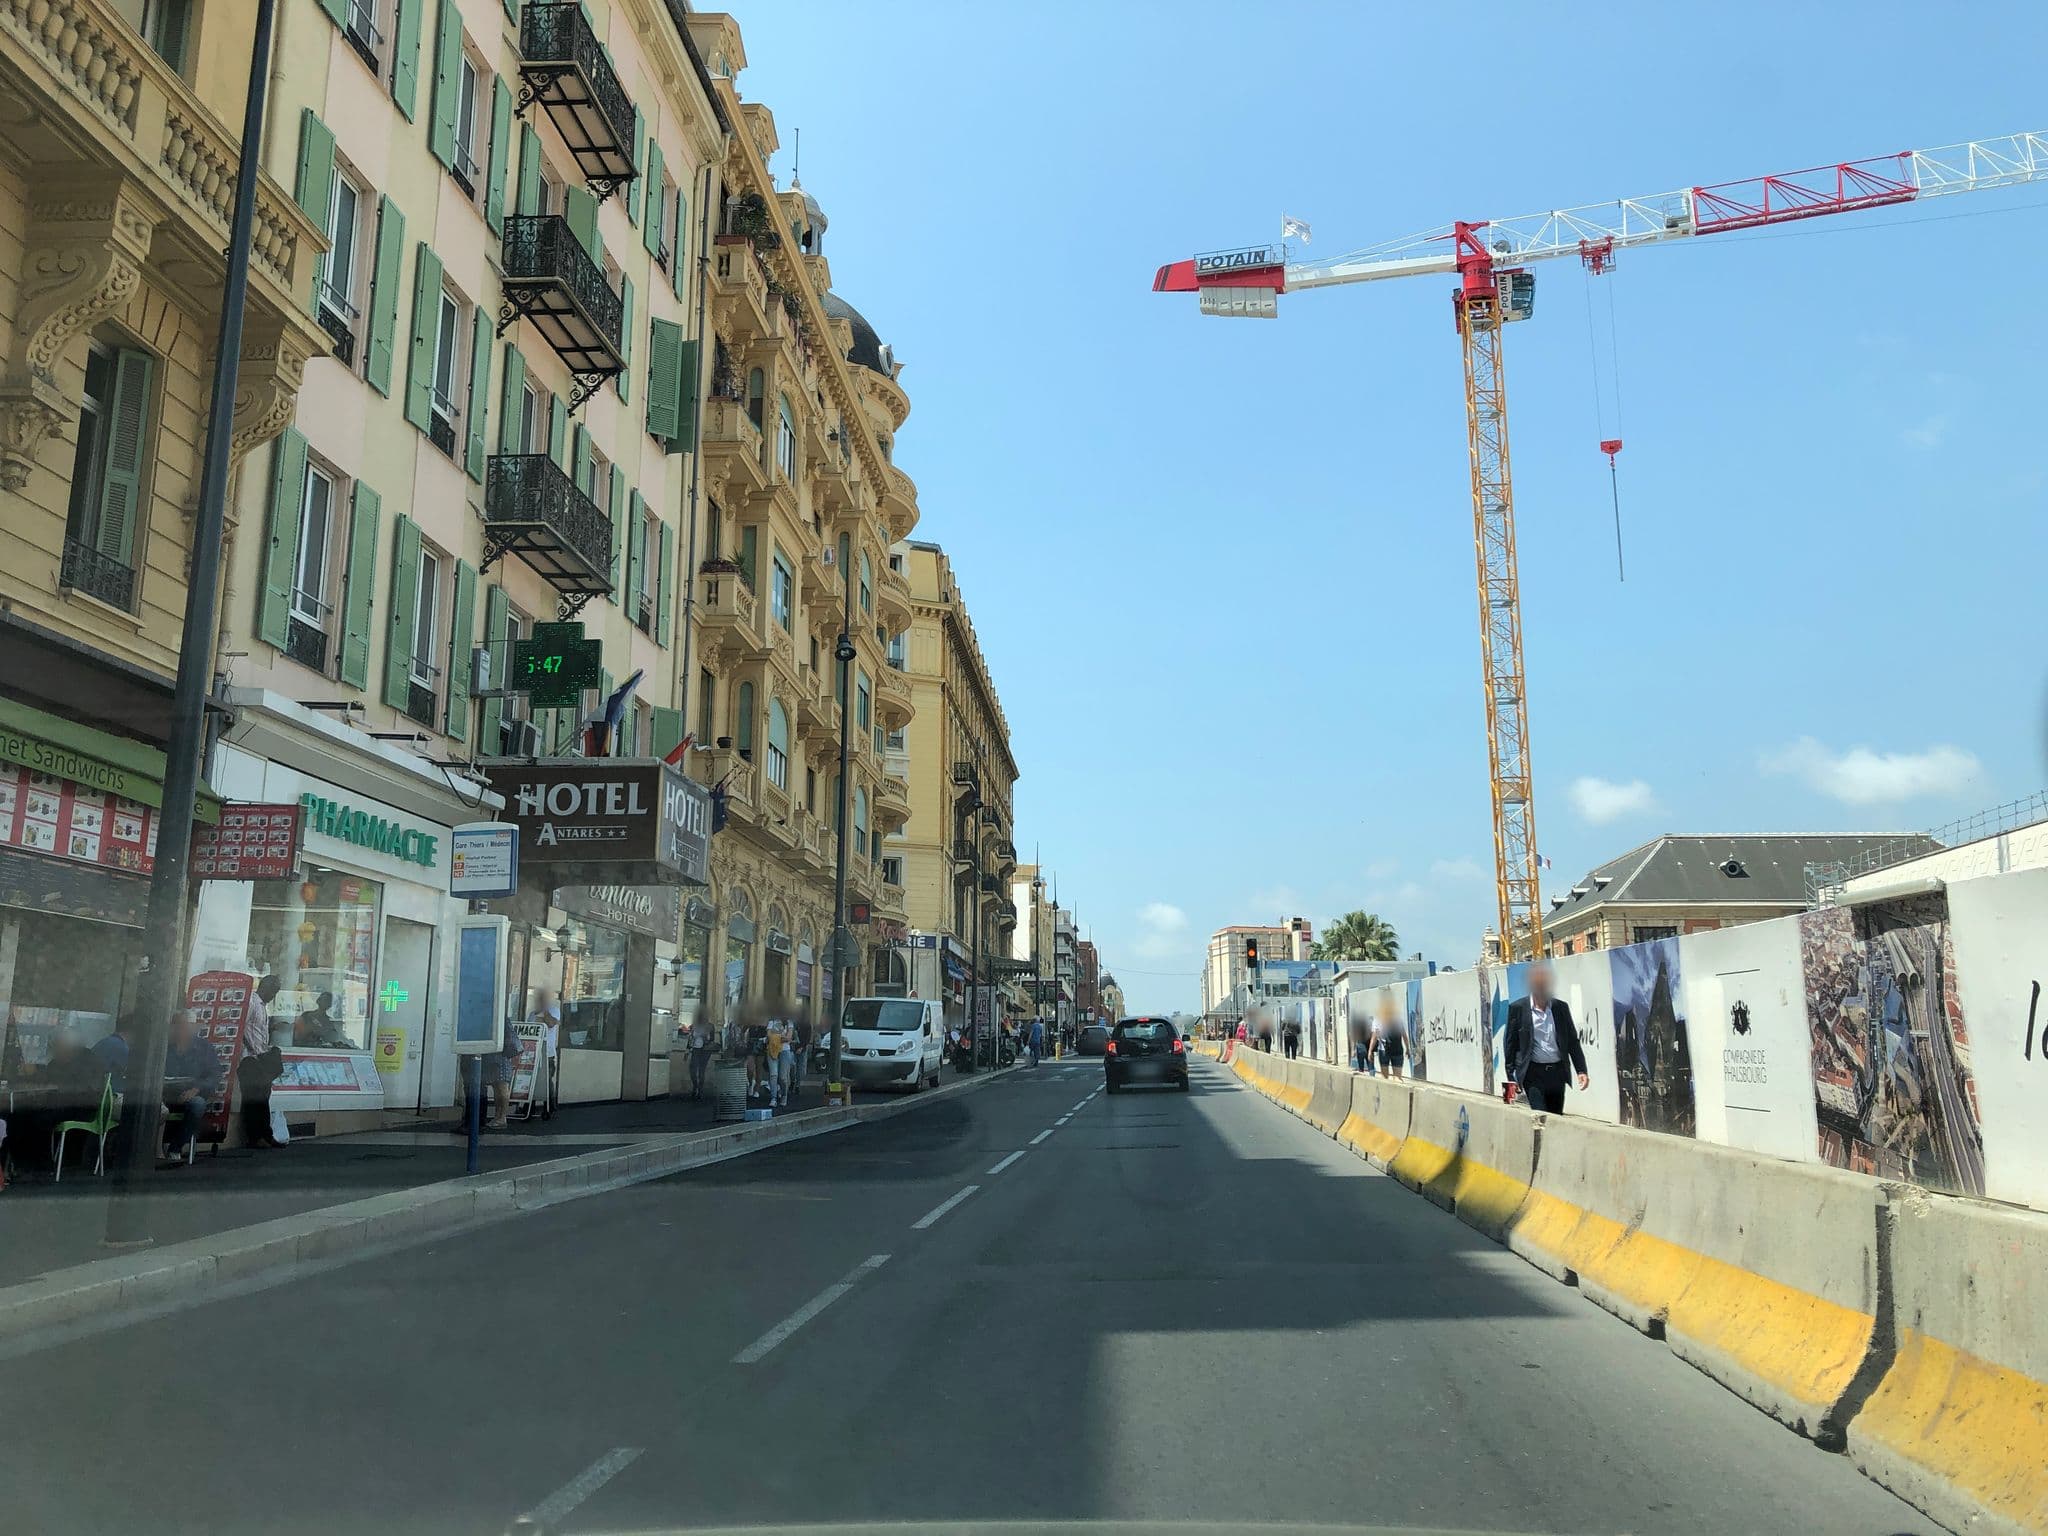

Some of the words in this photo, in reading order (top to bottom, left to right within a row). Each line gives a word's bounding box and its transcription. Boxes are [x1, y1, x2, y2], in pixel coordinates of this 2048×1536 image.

[1199, 250, 1266, 269] POTAIN
[1500, 276, 1509, 308] POTAIN
[32, 740, 125, 790] Sandwichs
[518, 782, 649, 816] HOTEL
[665, 781, 706, 840] HOTEL
[300, 792, 438, 868] PHARMACIE
[536, 823, 602, 846] ANTARES
[607, 908, 638, 927] HOTEL
